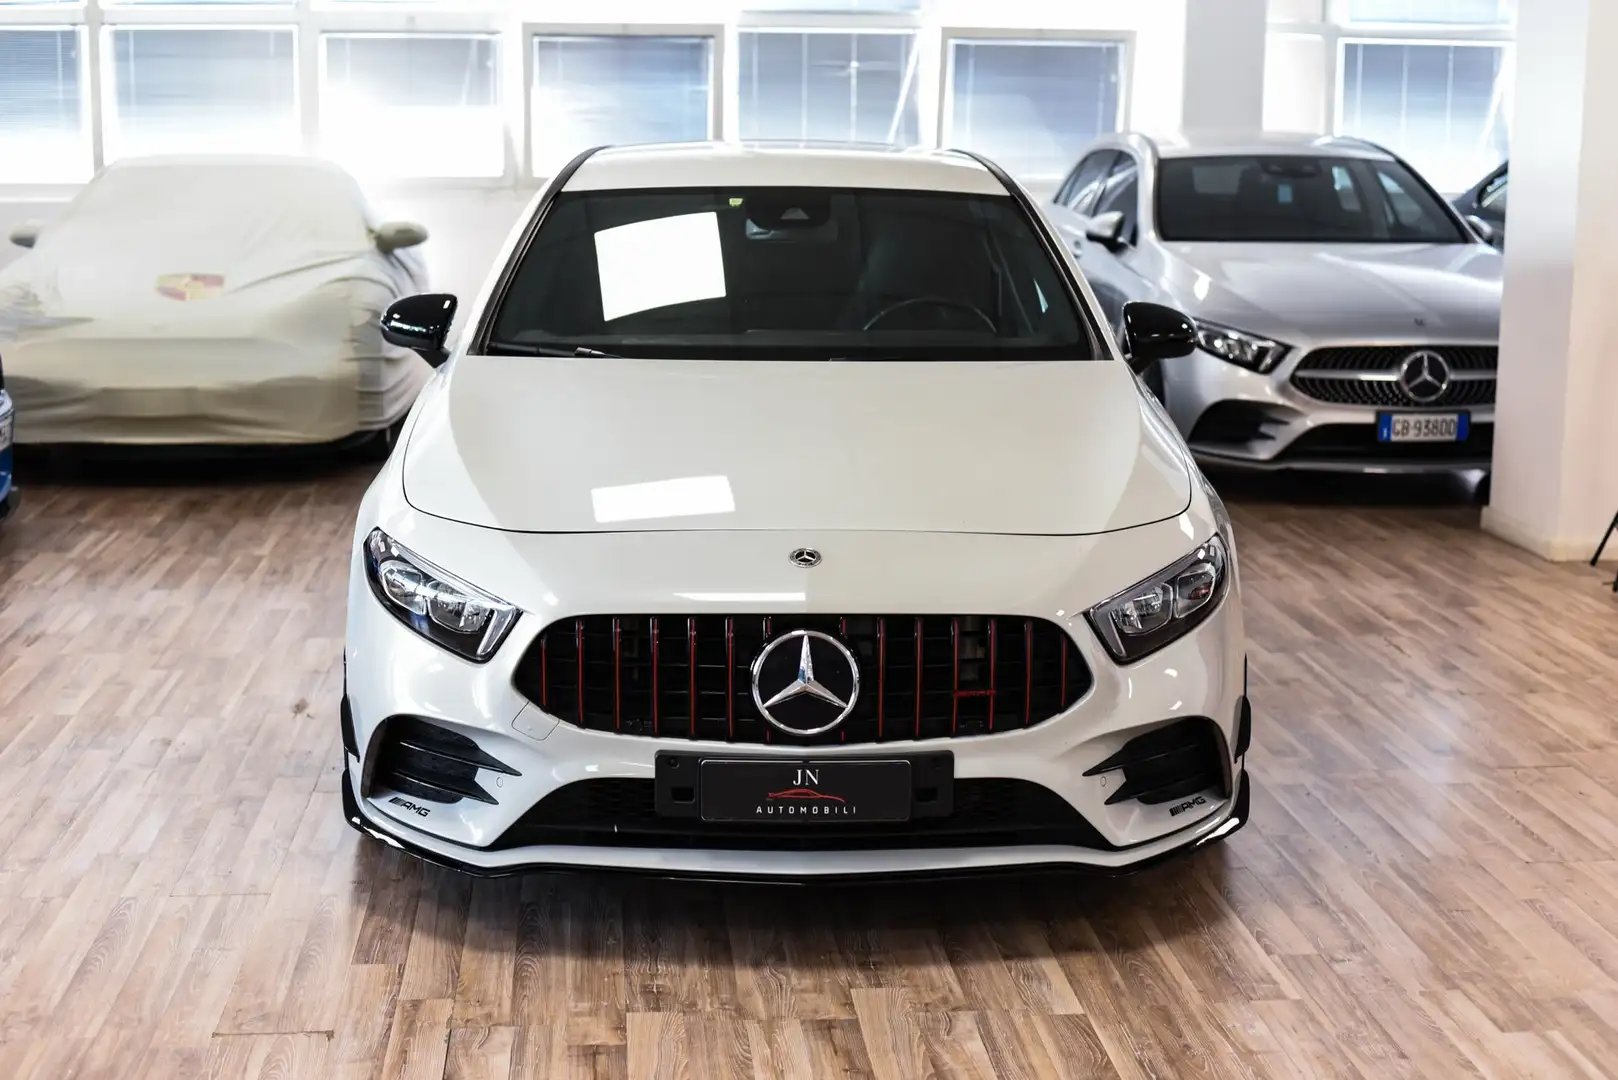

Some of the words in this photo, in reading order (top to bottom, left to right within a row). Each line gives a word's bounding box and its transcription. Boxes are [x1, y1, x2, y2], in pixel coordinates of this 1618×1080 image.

[793, 769, 819, 785] JN
[400, 801, 431, 817] AMG
[756, 806, 856, 814] AUTOMOBILI
